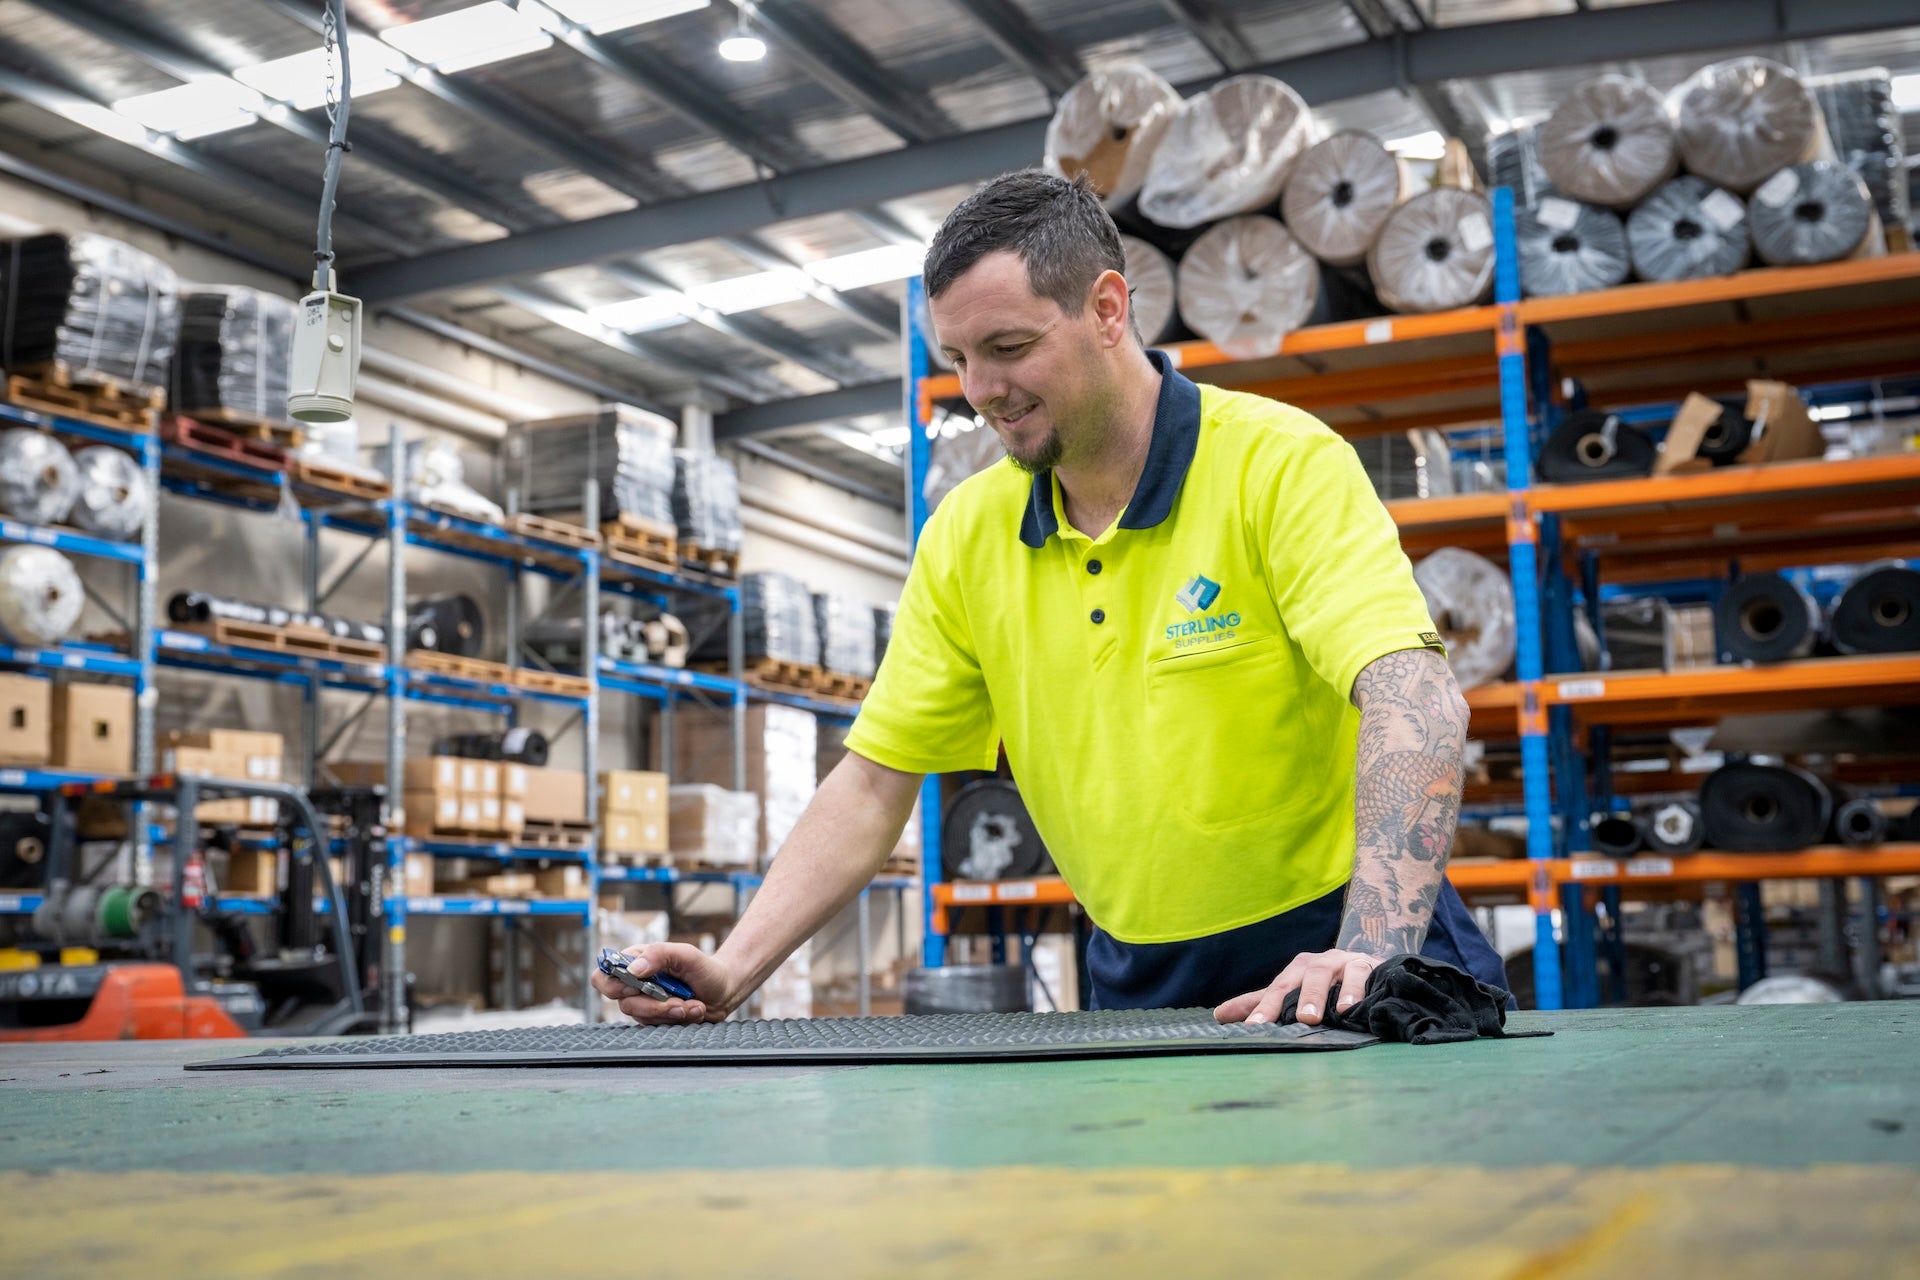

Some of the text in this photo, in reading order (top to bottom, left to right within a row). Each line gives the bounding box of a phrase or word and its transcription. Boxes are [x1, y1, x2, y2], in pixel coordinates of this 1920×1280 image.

[1166, 611, 1241, 639] STERLING
[1175, 630, 1236, 649] SUPPLIES
[0, 973, 79, 998] YOTA
